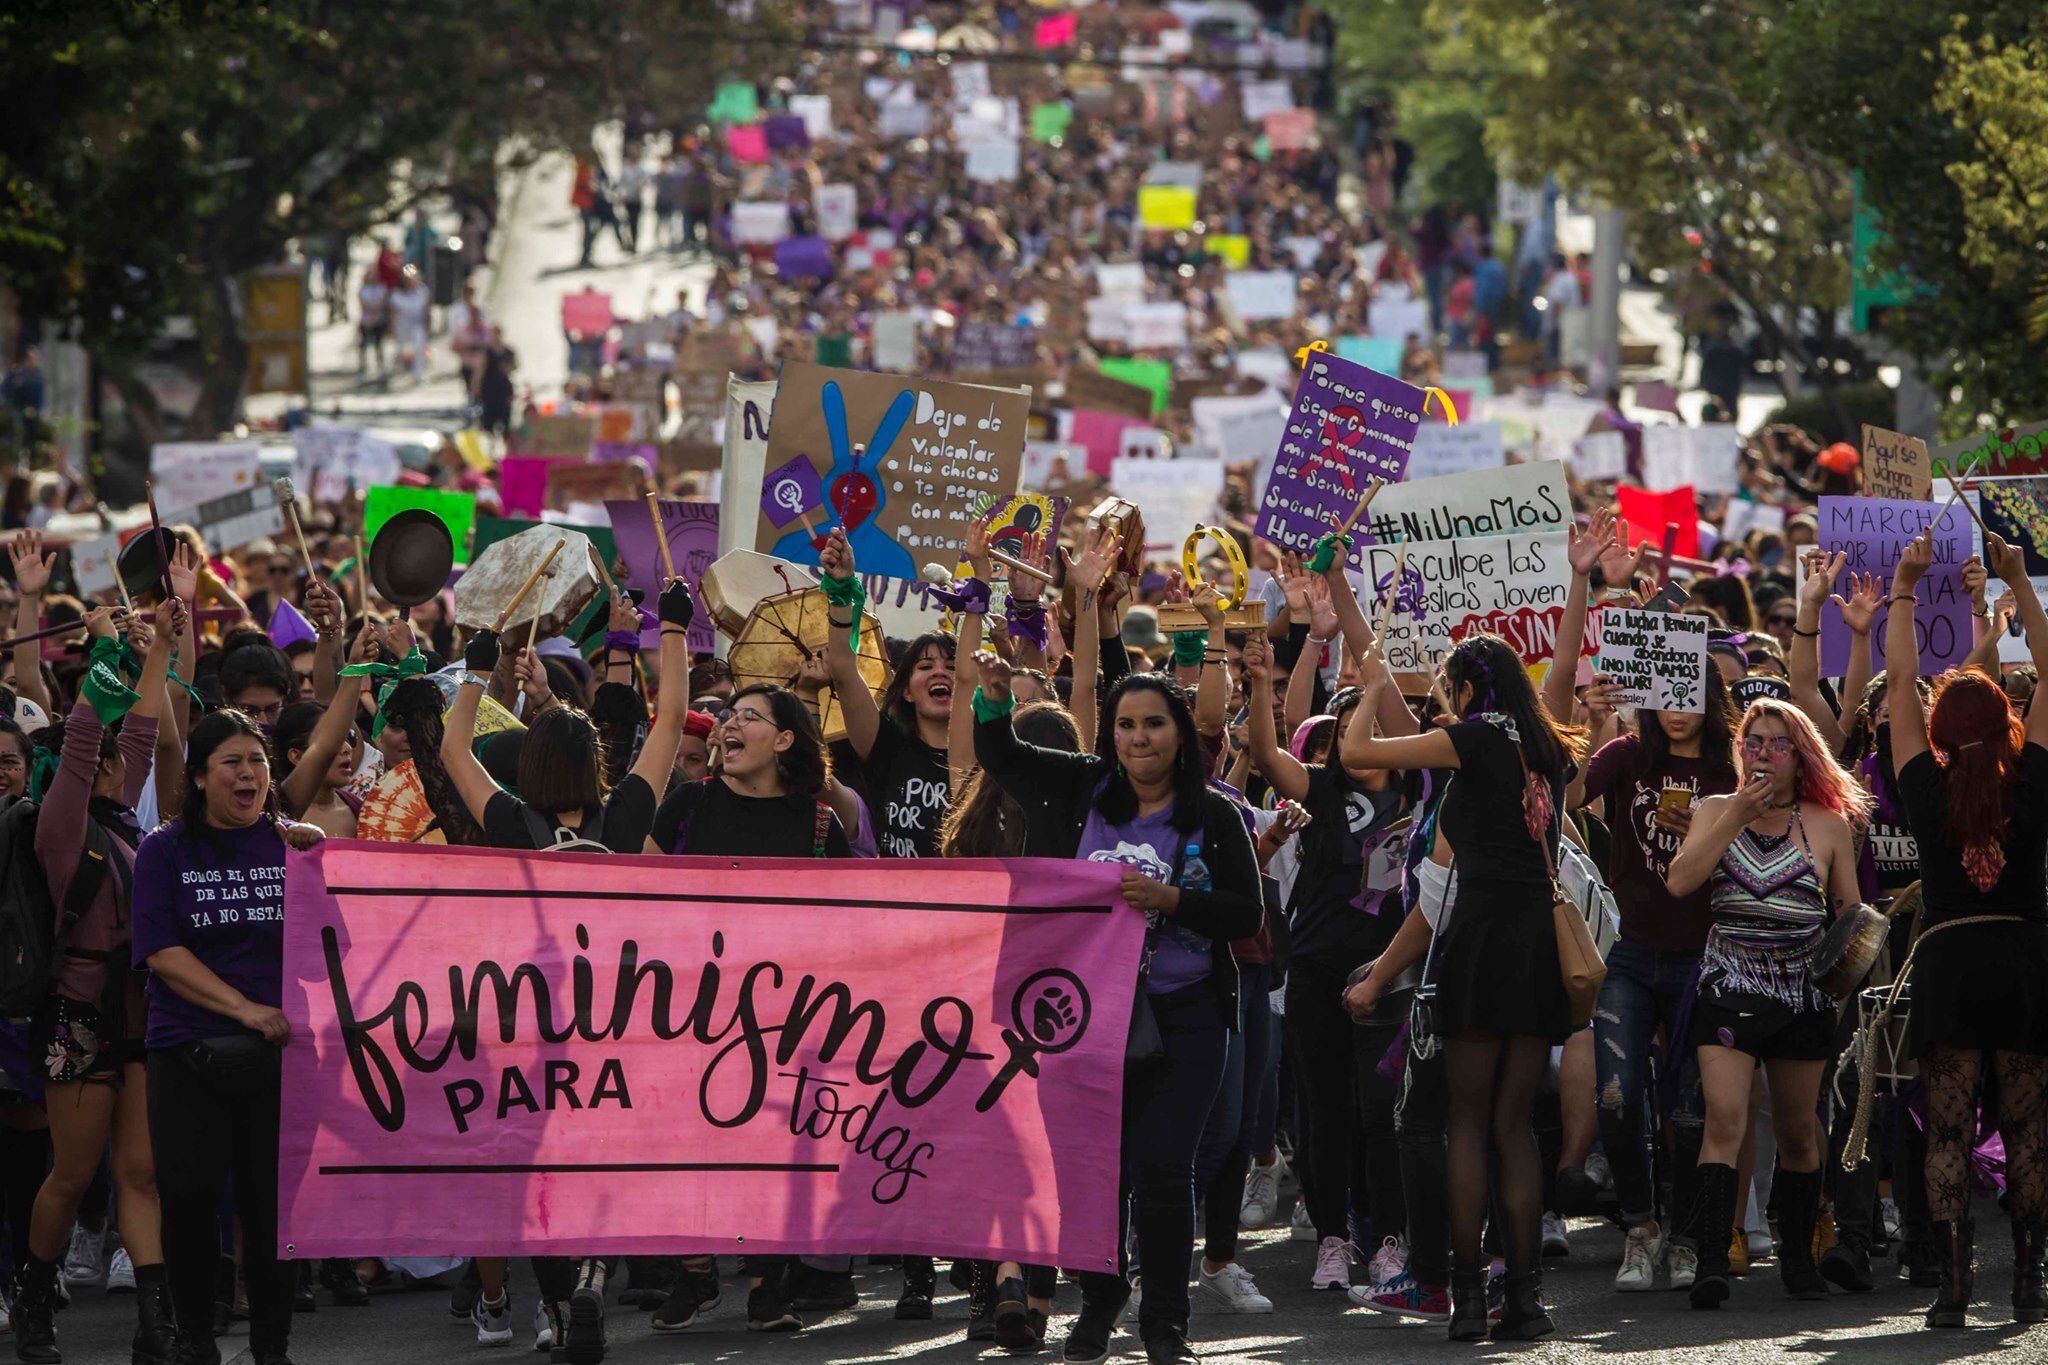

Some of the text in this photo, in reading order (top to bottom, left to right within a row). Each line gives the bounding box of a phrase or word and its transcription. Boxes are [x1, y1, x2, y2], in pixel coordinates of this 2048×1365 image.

[1309, 361, 1420, 424] Porque quiero
[915, 390, 1002, 438] Deja de
[1283, 442, 1356, 477] mi mami
[1289, 418, 1401, 474] de la mano de
[1901, 446, 1917, 466] se
[887, 454, 999, 483] a las chicas
[1275, 457, 1298, 479] de
[893, 481, 904, 492] o
[914, 478, 934, 496] te
[1831, 506, 1955, 534] MARCHO
[896, 524, 968, 550] Pancar
[1369, 540, 1494, 592] Disculpe
[1830, 540, 1868, 567] POR
[1931, 538, 1958, 565] QUE
[1494, 580, 1567, 610] Joven
[1603, 610, 1706, 634] La lucha termina
[1634, 647, 1699, 664] abandona
[1651, 634, 1666, 650] se
[1626, 659, 1653, 676] NOS
[1653, 661, 1700, 681] VAMOS
[1740, 681, 1779, 698] VODKA
[905, 777, 953, 810] POR
[888, 801, 926, 830] POR
[889, 833, 919, 859] POR
[181, 869, 222, 884] SOMOS
[227, 869, 245, 882] EL
[195, 884, 284, 902] DE LAS QUE
[190, 904, 285, 928] YA NO ESTÁ
[320, 922, 993, 1133] feminismo
[441, 1056, 633, 1135] PARA
[776, 1066, 934, 1205] todas
